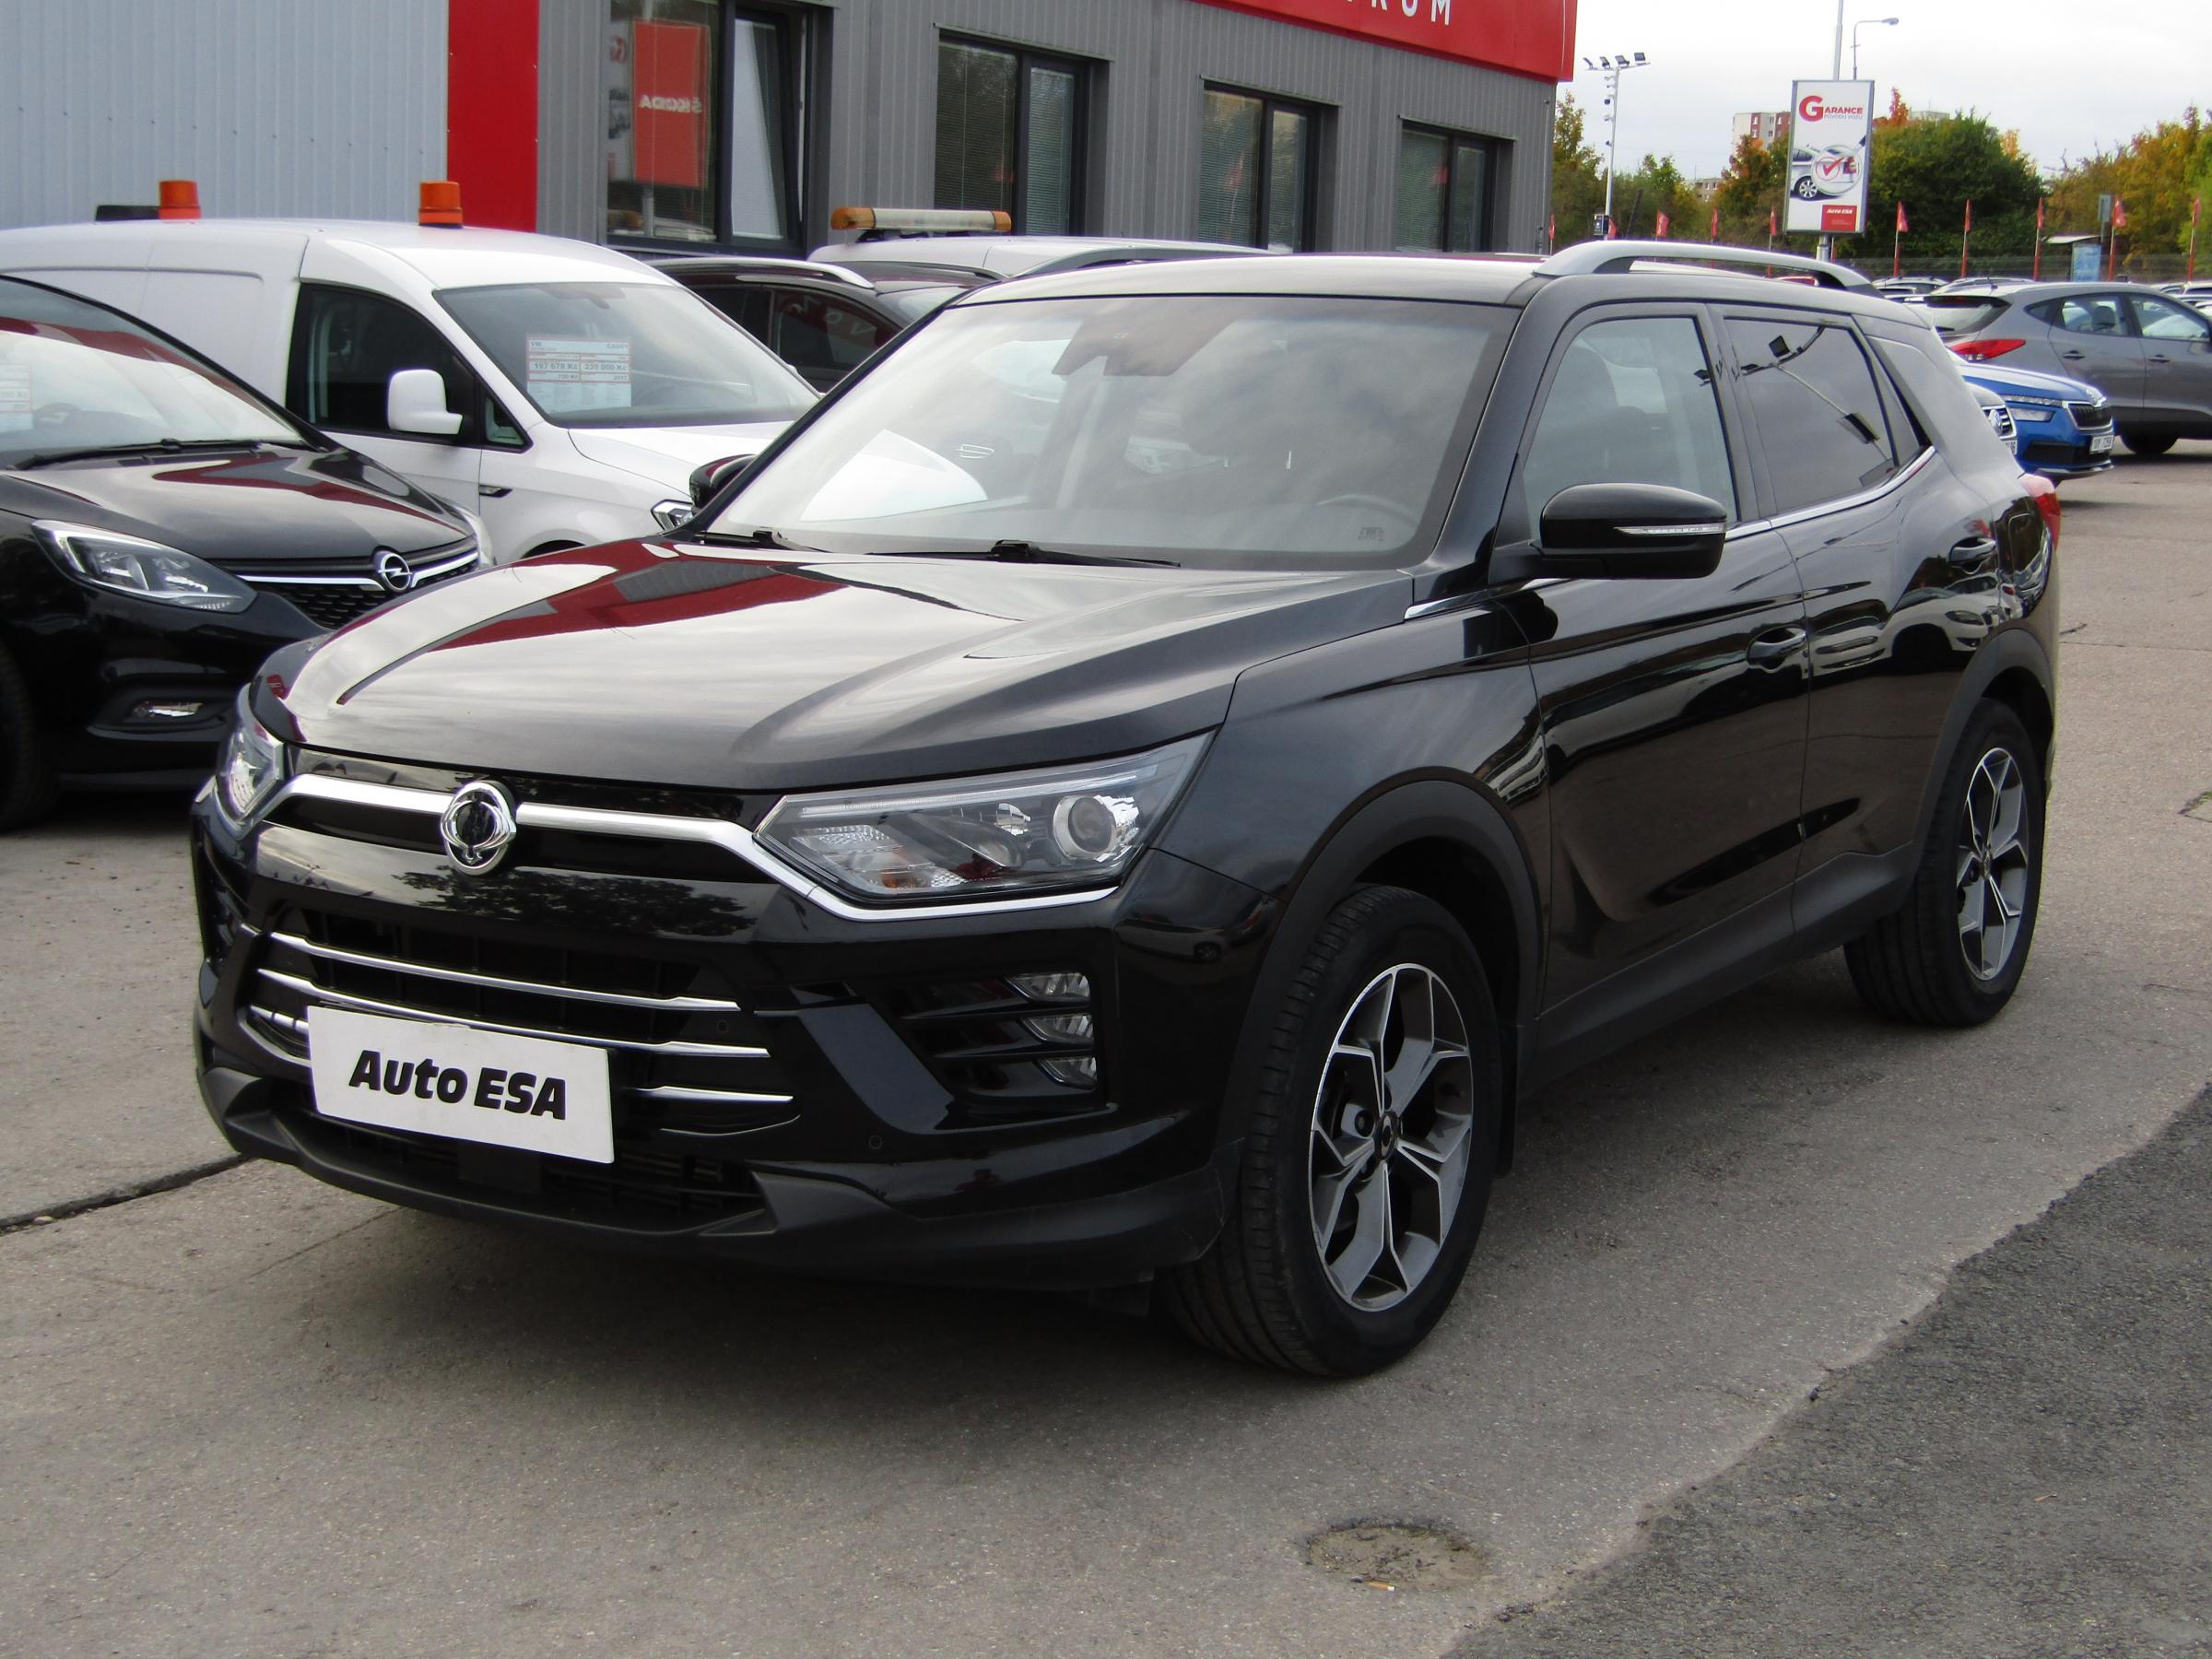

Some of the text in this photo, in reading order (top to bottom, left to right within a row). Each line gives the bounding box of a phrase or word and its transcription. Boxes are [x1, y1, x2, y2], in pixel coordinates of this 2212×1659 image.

[1799, 95, 1864, 123] GARANCE
[348, 1049, 566, 1121] Auto ESA
